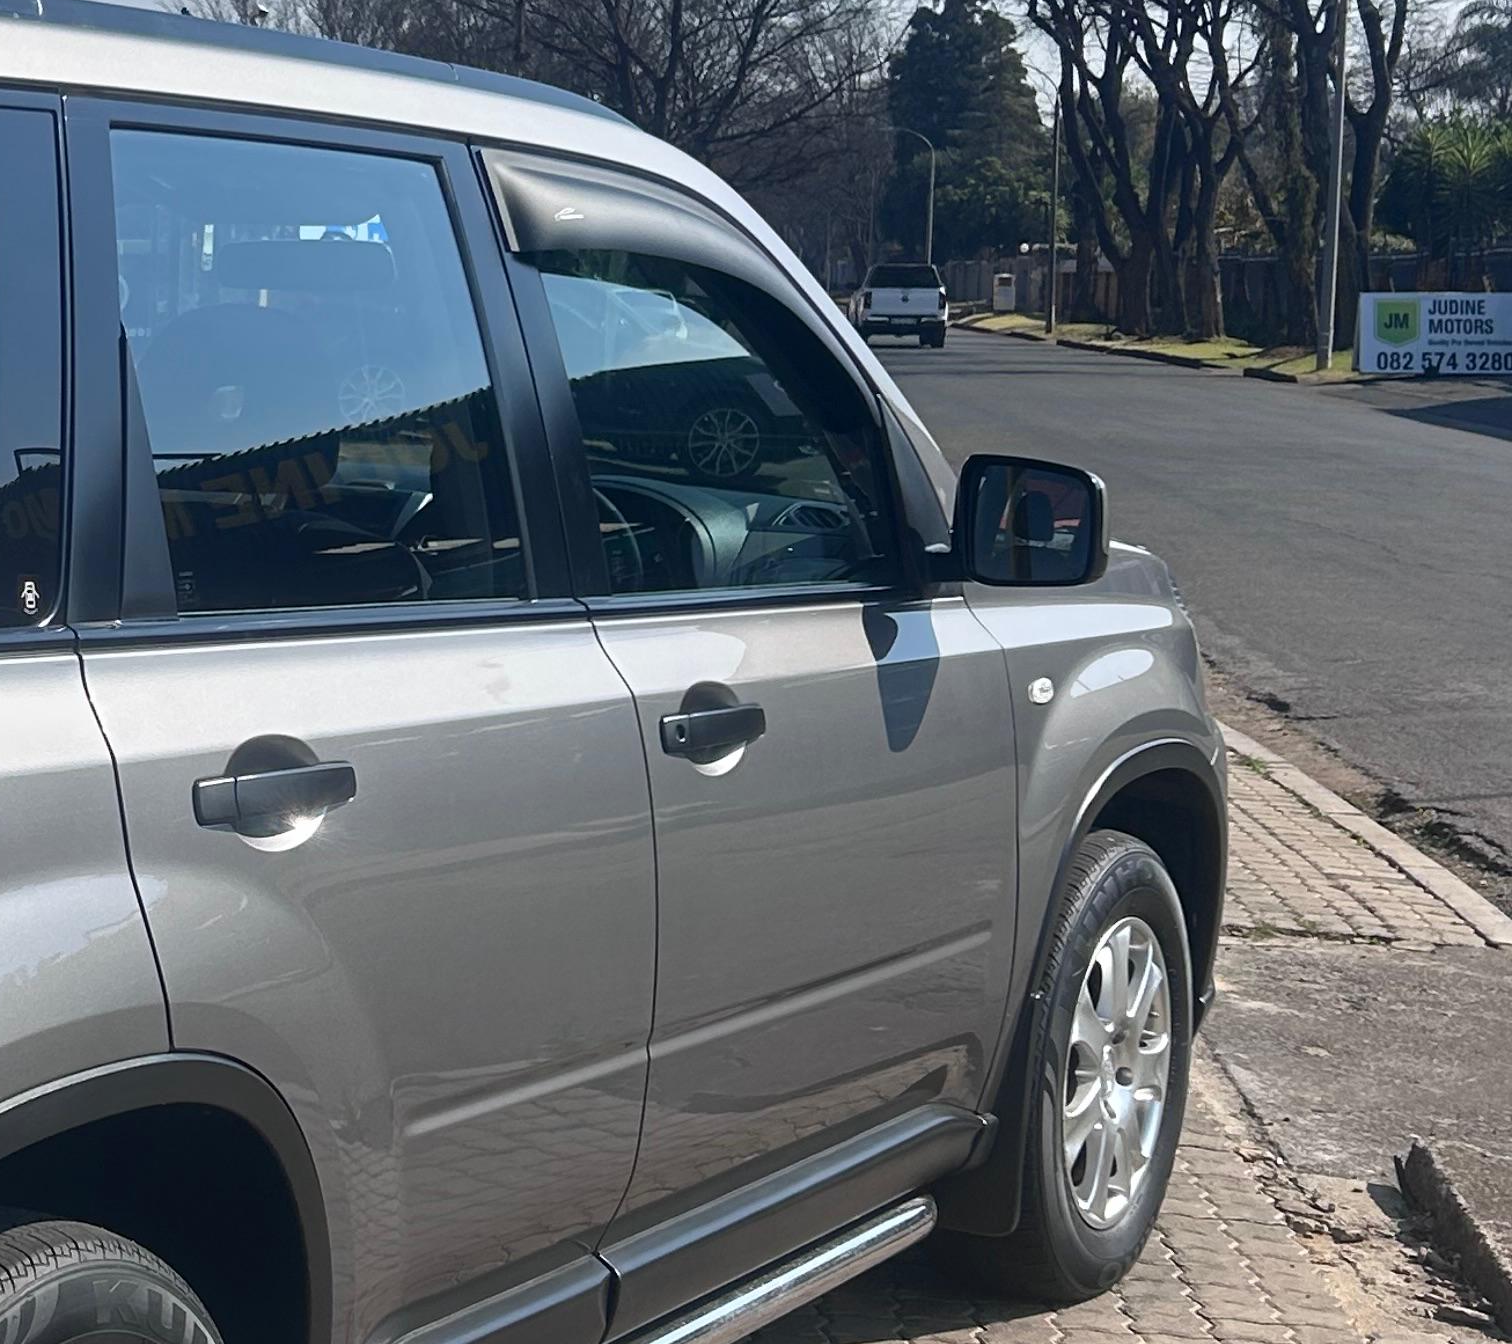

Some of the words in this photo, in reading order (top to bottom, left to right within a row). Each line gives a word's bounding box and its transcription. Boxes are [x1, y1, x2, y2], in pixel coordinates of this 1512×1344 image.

[1428, 299, 1486, 315] JUDINE
[1383, 312, 1410, 329] JM
[1428, 318, 1494, 335] MOTORS
[1376, 351, 1414, 370] 082
[1421, 351, 1458, 371] 574
[1465, 351, 1512, 371] 3280
